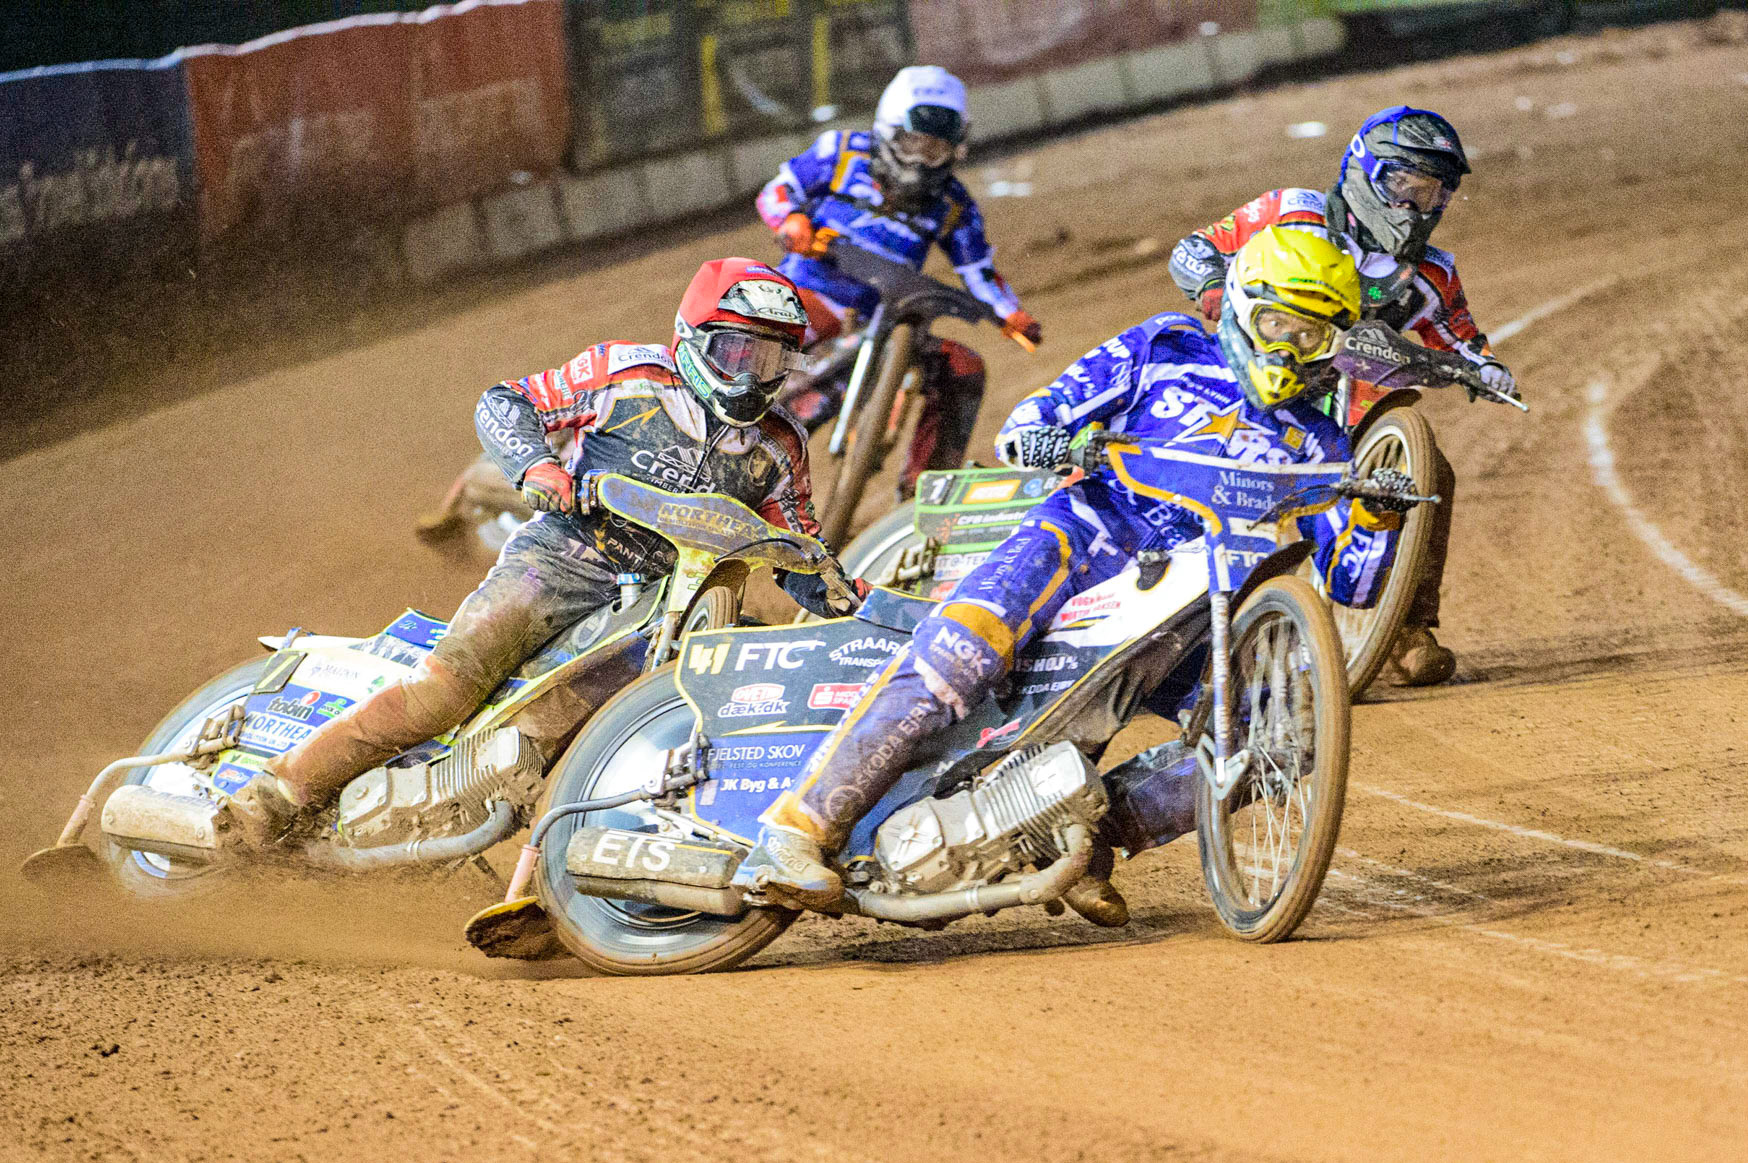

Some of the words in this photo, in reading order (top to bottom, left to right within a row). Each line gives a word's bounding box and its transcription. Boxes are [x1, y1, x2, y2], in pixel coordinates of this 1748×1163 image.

[617, 351, 674, 368] Crendon
[1344, 336, 1411, 366] Crendon
[1218, 470, 1276, 492] Minors
[1211, 484, 1233, 506] &
[1225, 550, 1269, 568] FTC
[1342, 530, 1373, 584] FTC
[734, 639, 827, 671] FTC
[933, 625, 993, 678] NGK
[767, 744, 806, 759] SKOV
[720, 778, 740, 792] JK
[740, 777, 766, 793] Byg
[767, 777, 780, 790] &
[780, 777, 795, 790] A
